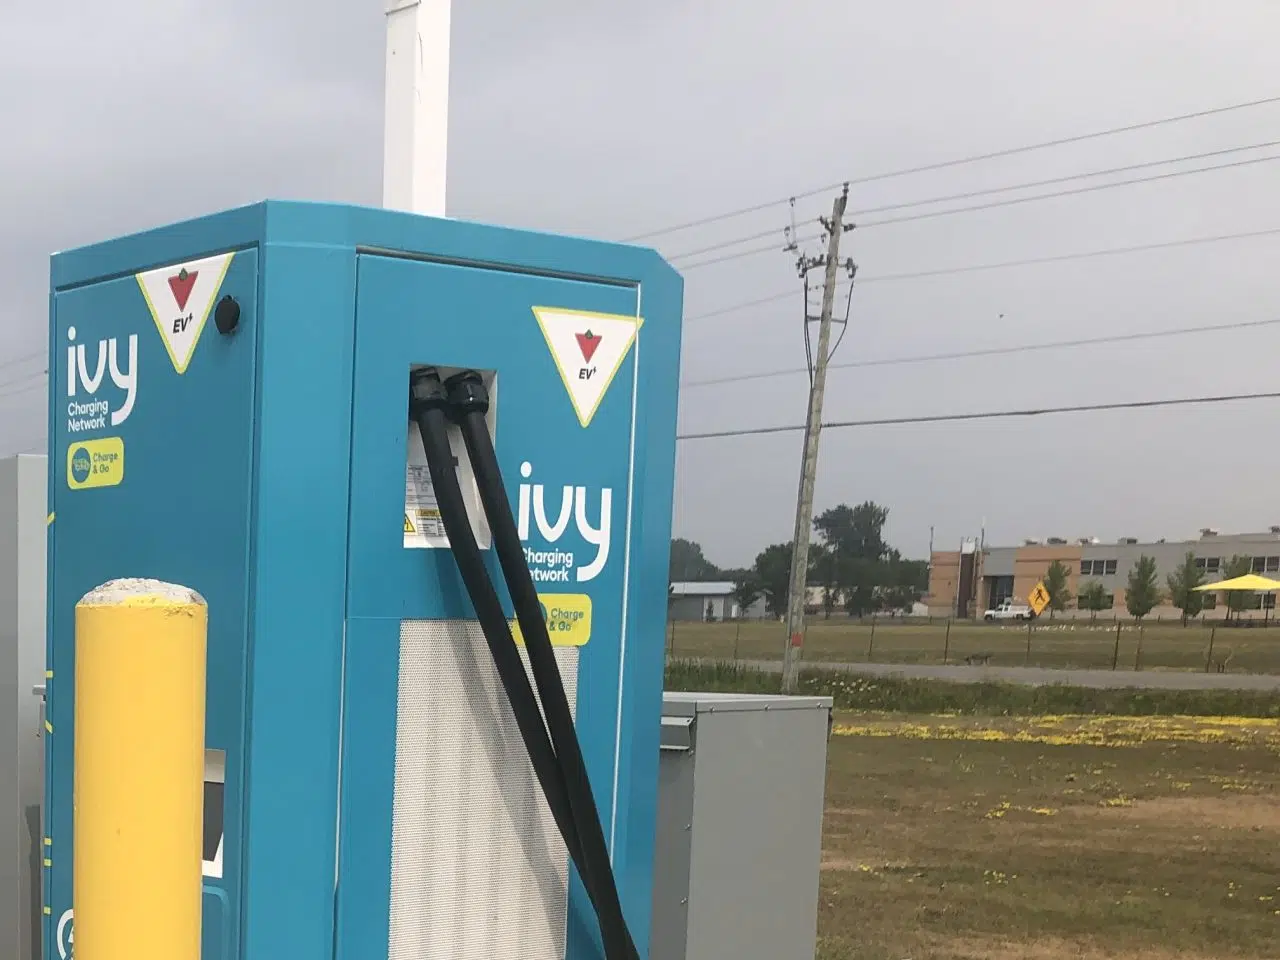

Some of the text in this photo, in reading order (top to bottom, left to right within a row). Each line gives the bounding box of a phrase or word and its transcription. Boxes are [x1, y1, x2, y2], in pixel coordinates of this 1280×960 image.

[67, 326, 138, 426] ivy
[67, 398, 109, 417] Charging
[67, 413, 106, 433] Network
[93, 452, 118, 463] Charge
[518, 461, 612, 582] ivy
[529, 565, 569, 582] twork
[550, 608, 584, 621] Charge
[549, 621, 571, 631] & Go
